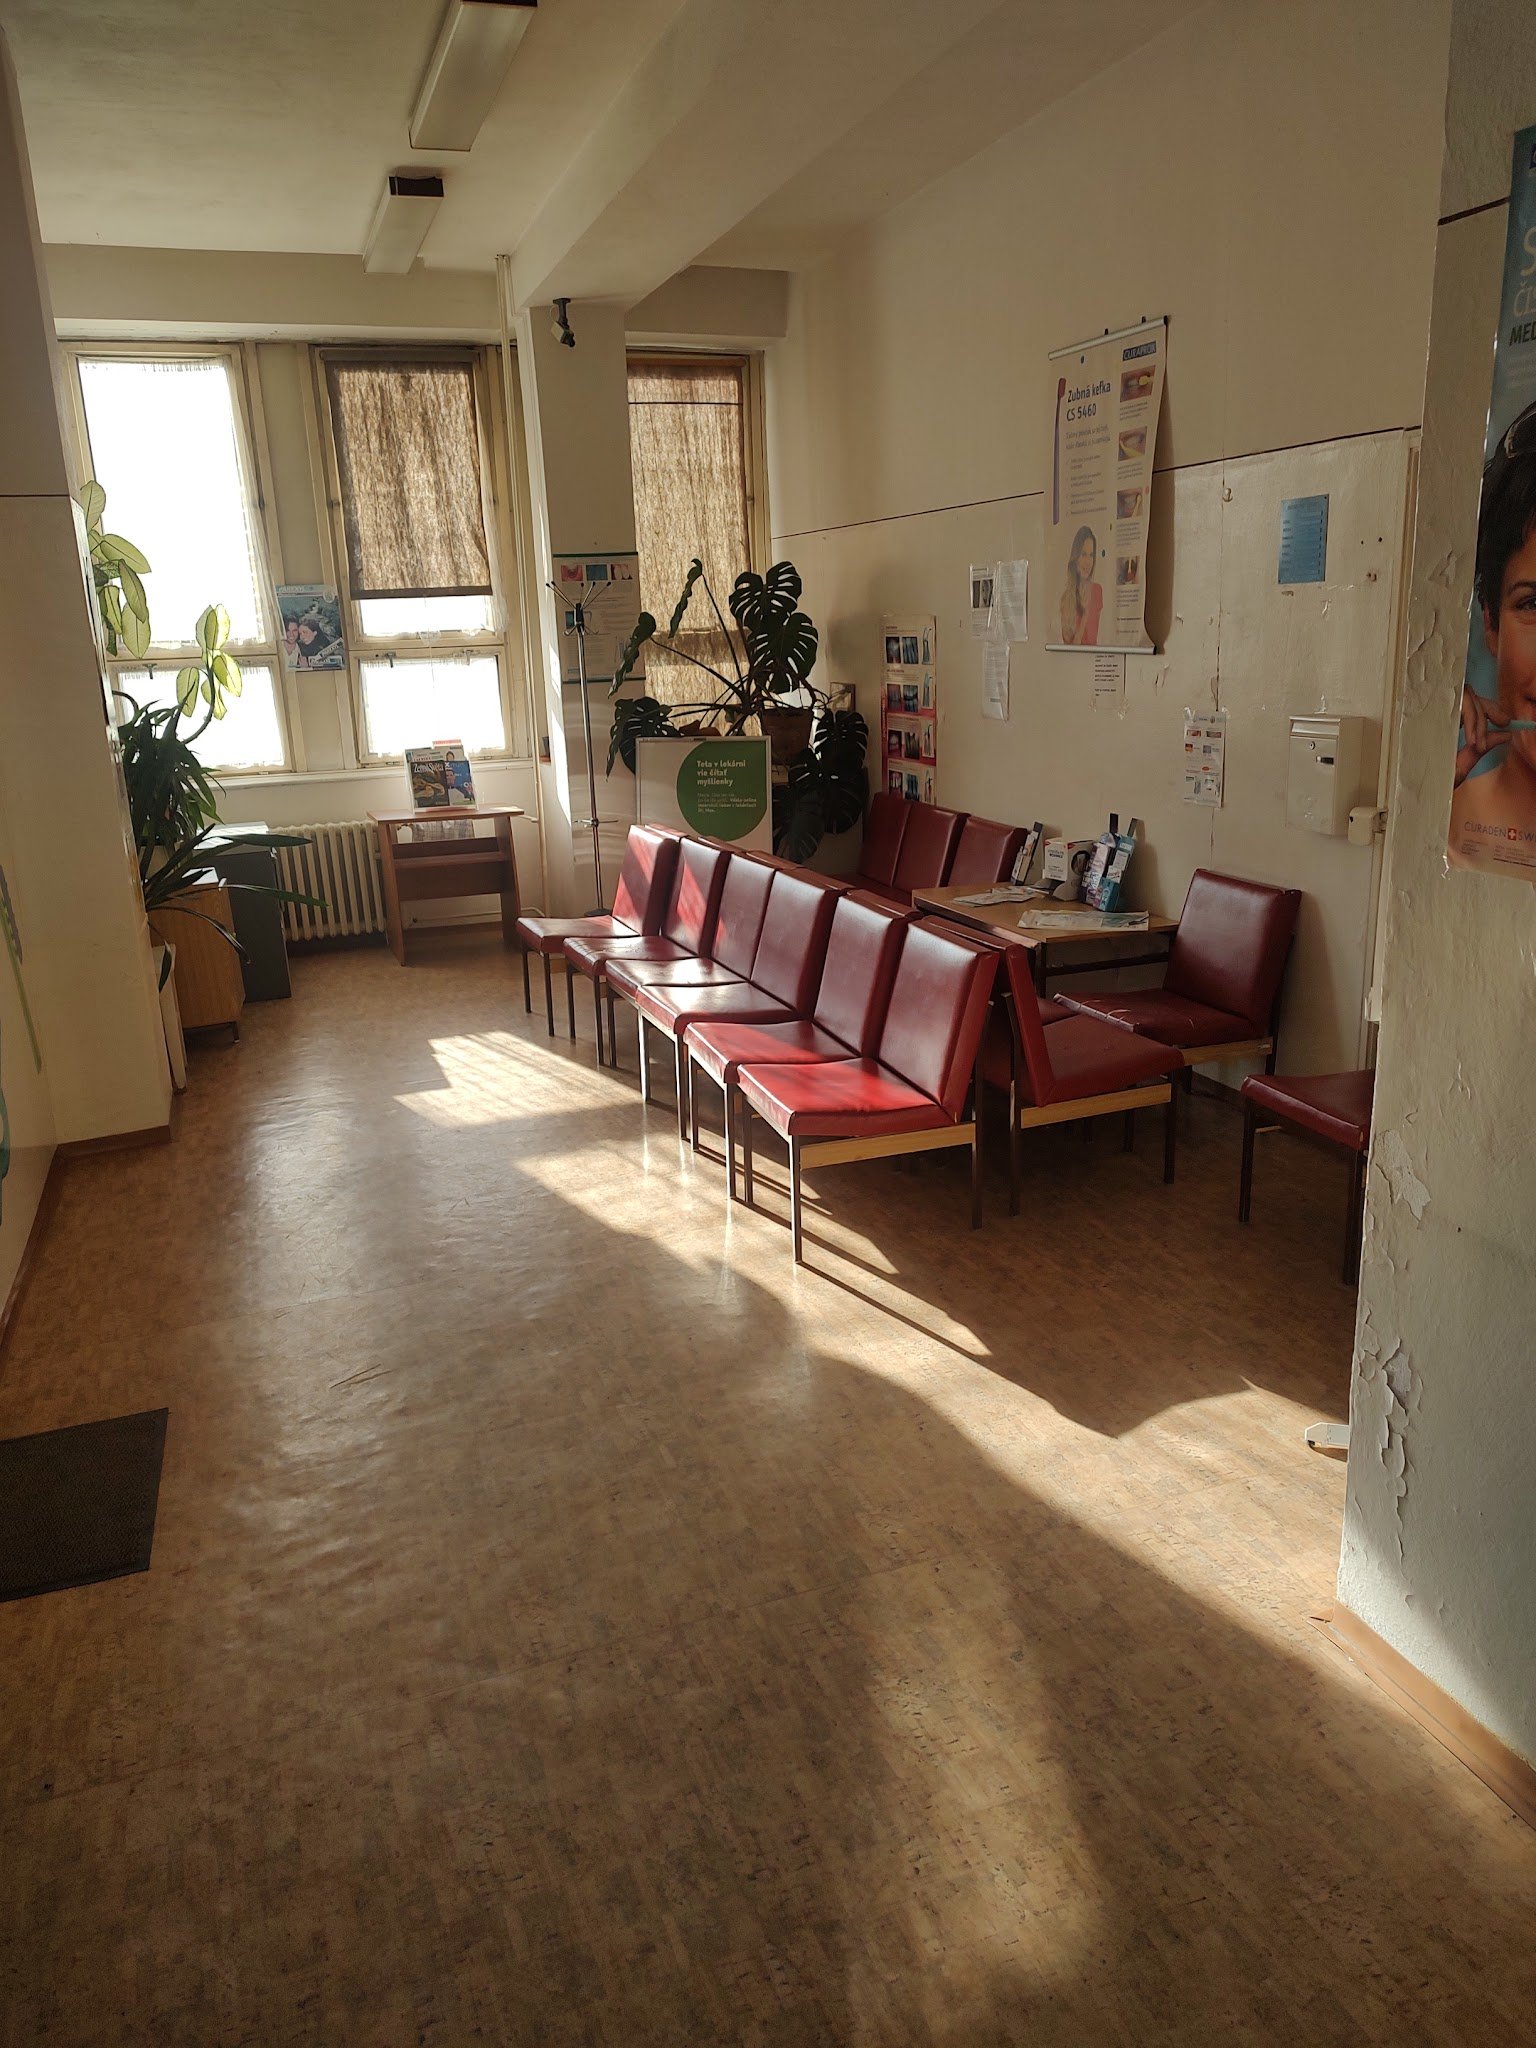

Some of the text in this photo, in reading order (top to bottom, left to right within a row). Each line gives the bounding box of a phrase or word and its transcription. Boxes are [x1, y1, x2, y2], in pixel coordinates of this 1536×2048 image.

[1067, 385, 1090, 403] Zubná
[1066, 403, 1097, 422] CS 5460
[1465, 821, 1506, 838] CURADEN
